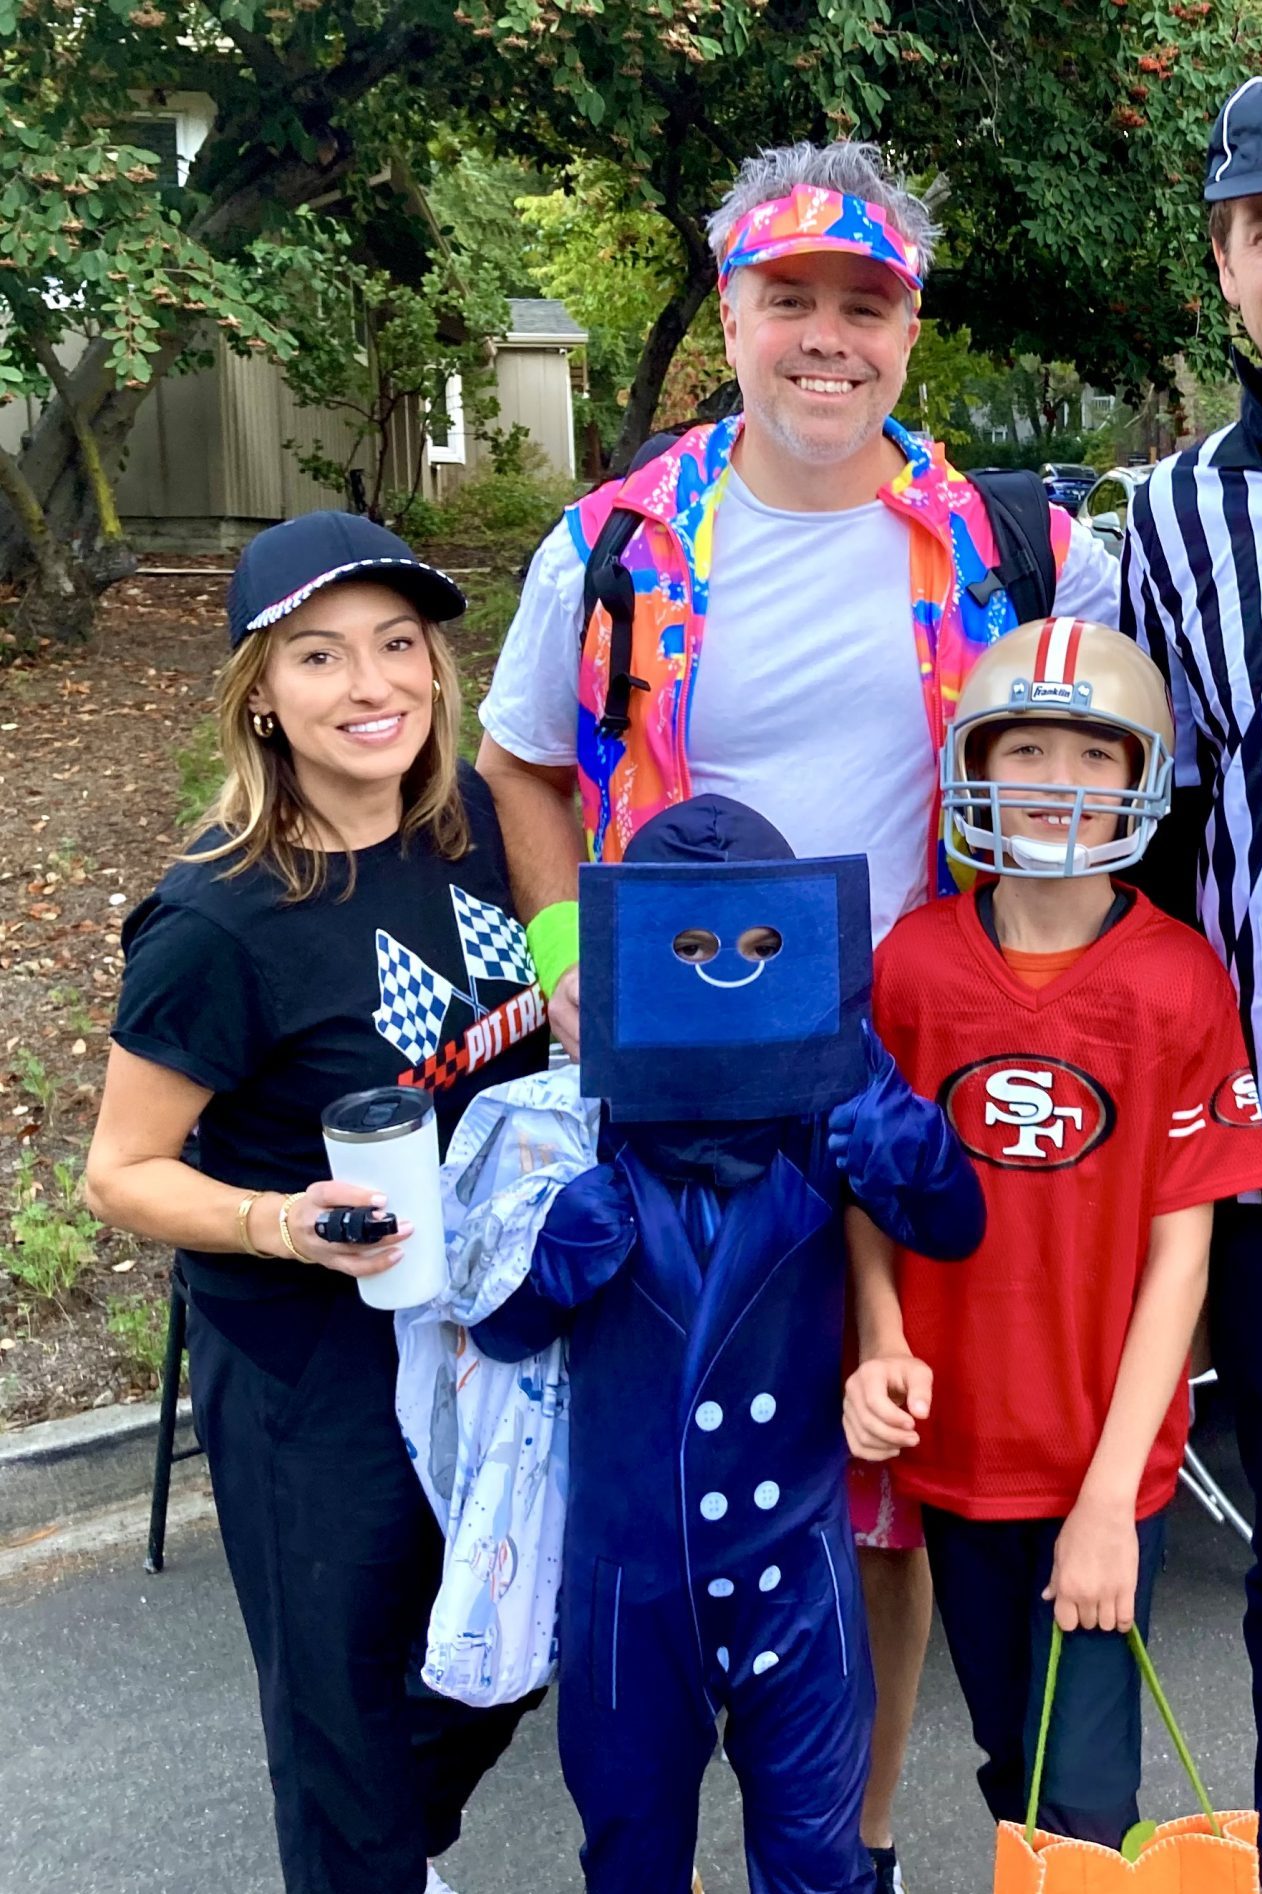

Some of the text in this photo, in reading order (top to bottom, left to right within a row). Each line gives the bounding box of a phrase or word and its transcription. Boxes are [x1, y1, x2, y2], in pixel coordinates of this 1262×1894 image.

[466, 983, 546, 1075] PIT CRE
[984, 1069, 1082, 1158] SF
